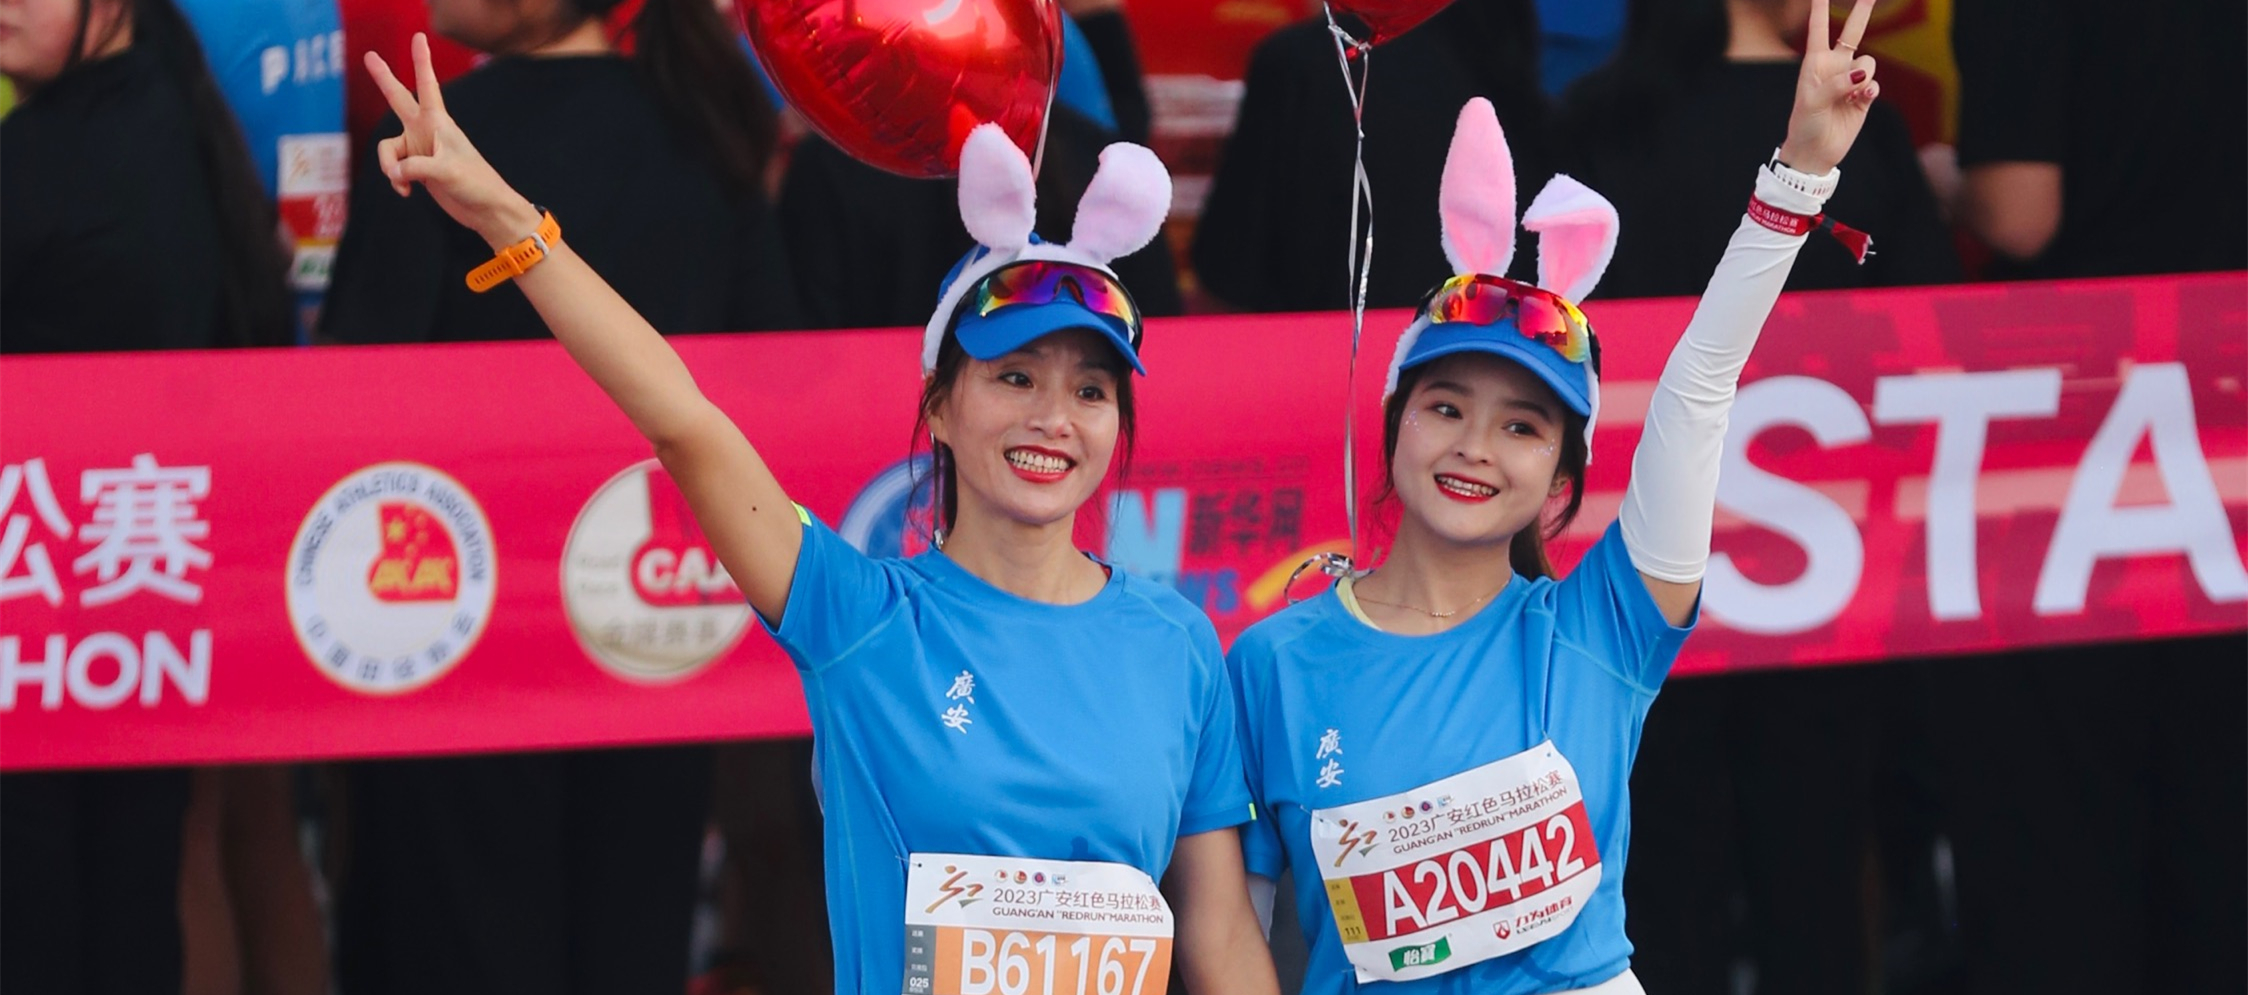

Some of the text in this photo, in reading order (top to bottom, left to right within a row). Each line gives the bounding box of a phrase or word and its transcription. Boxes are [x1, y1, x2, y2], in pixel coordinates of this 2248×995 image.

[1702, 362, 2248, 635] STA
[0, 629, 213, 713] HON
[1382, 813, 1586, 936] A20442
[960, 929, 1157, 995] B61167
[1344, 926, 1361, 936] 111
[909, 976, 930, 989] 025
